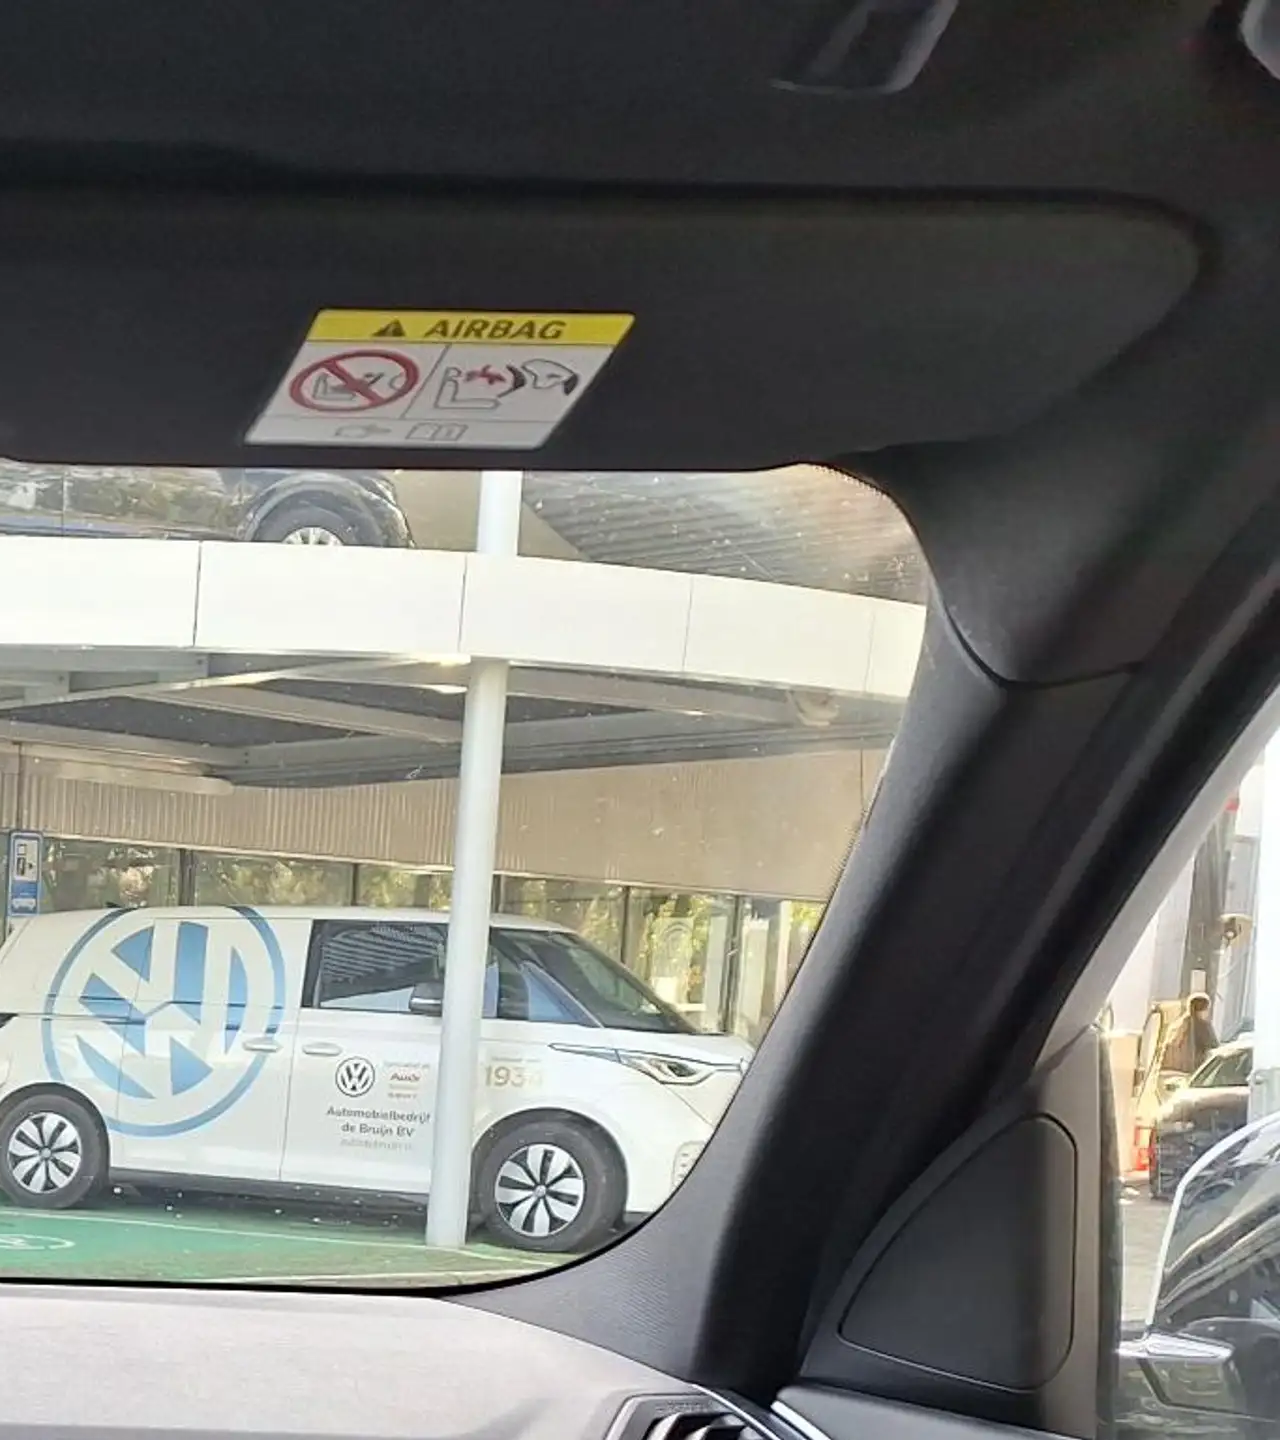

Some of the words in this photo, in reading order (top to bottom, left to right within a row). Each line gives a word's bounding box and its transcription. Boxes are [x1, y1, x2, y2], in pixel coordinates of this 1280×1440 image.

[423, 318, 567, 340] AIRBAG
[326, 1105, 432, 1123] Automobielbedrijf
[341, 1123, 357, 1134] de
[359, 1123, 395, 1137] Bruijn
[396, 1126, 417, 1138] BV
